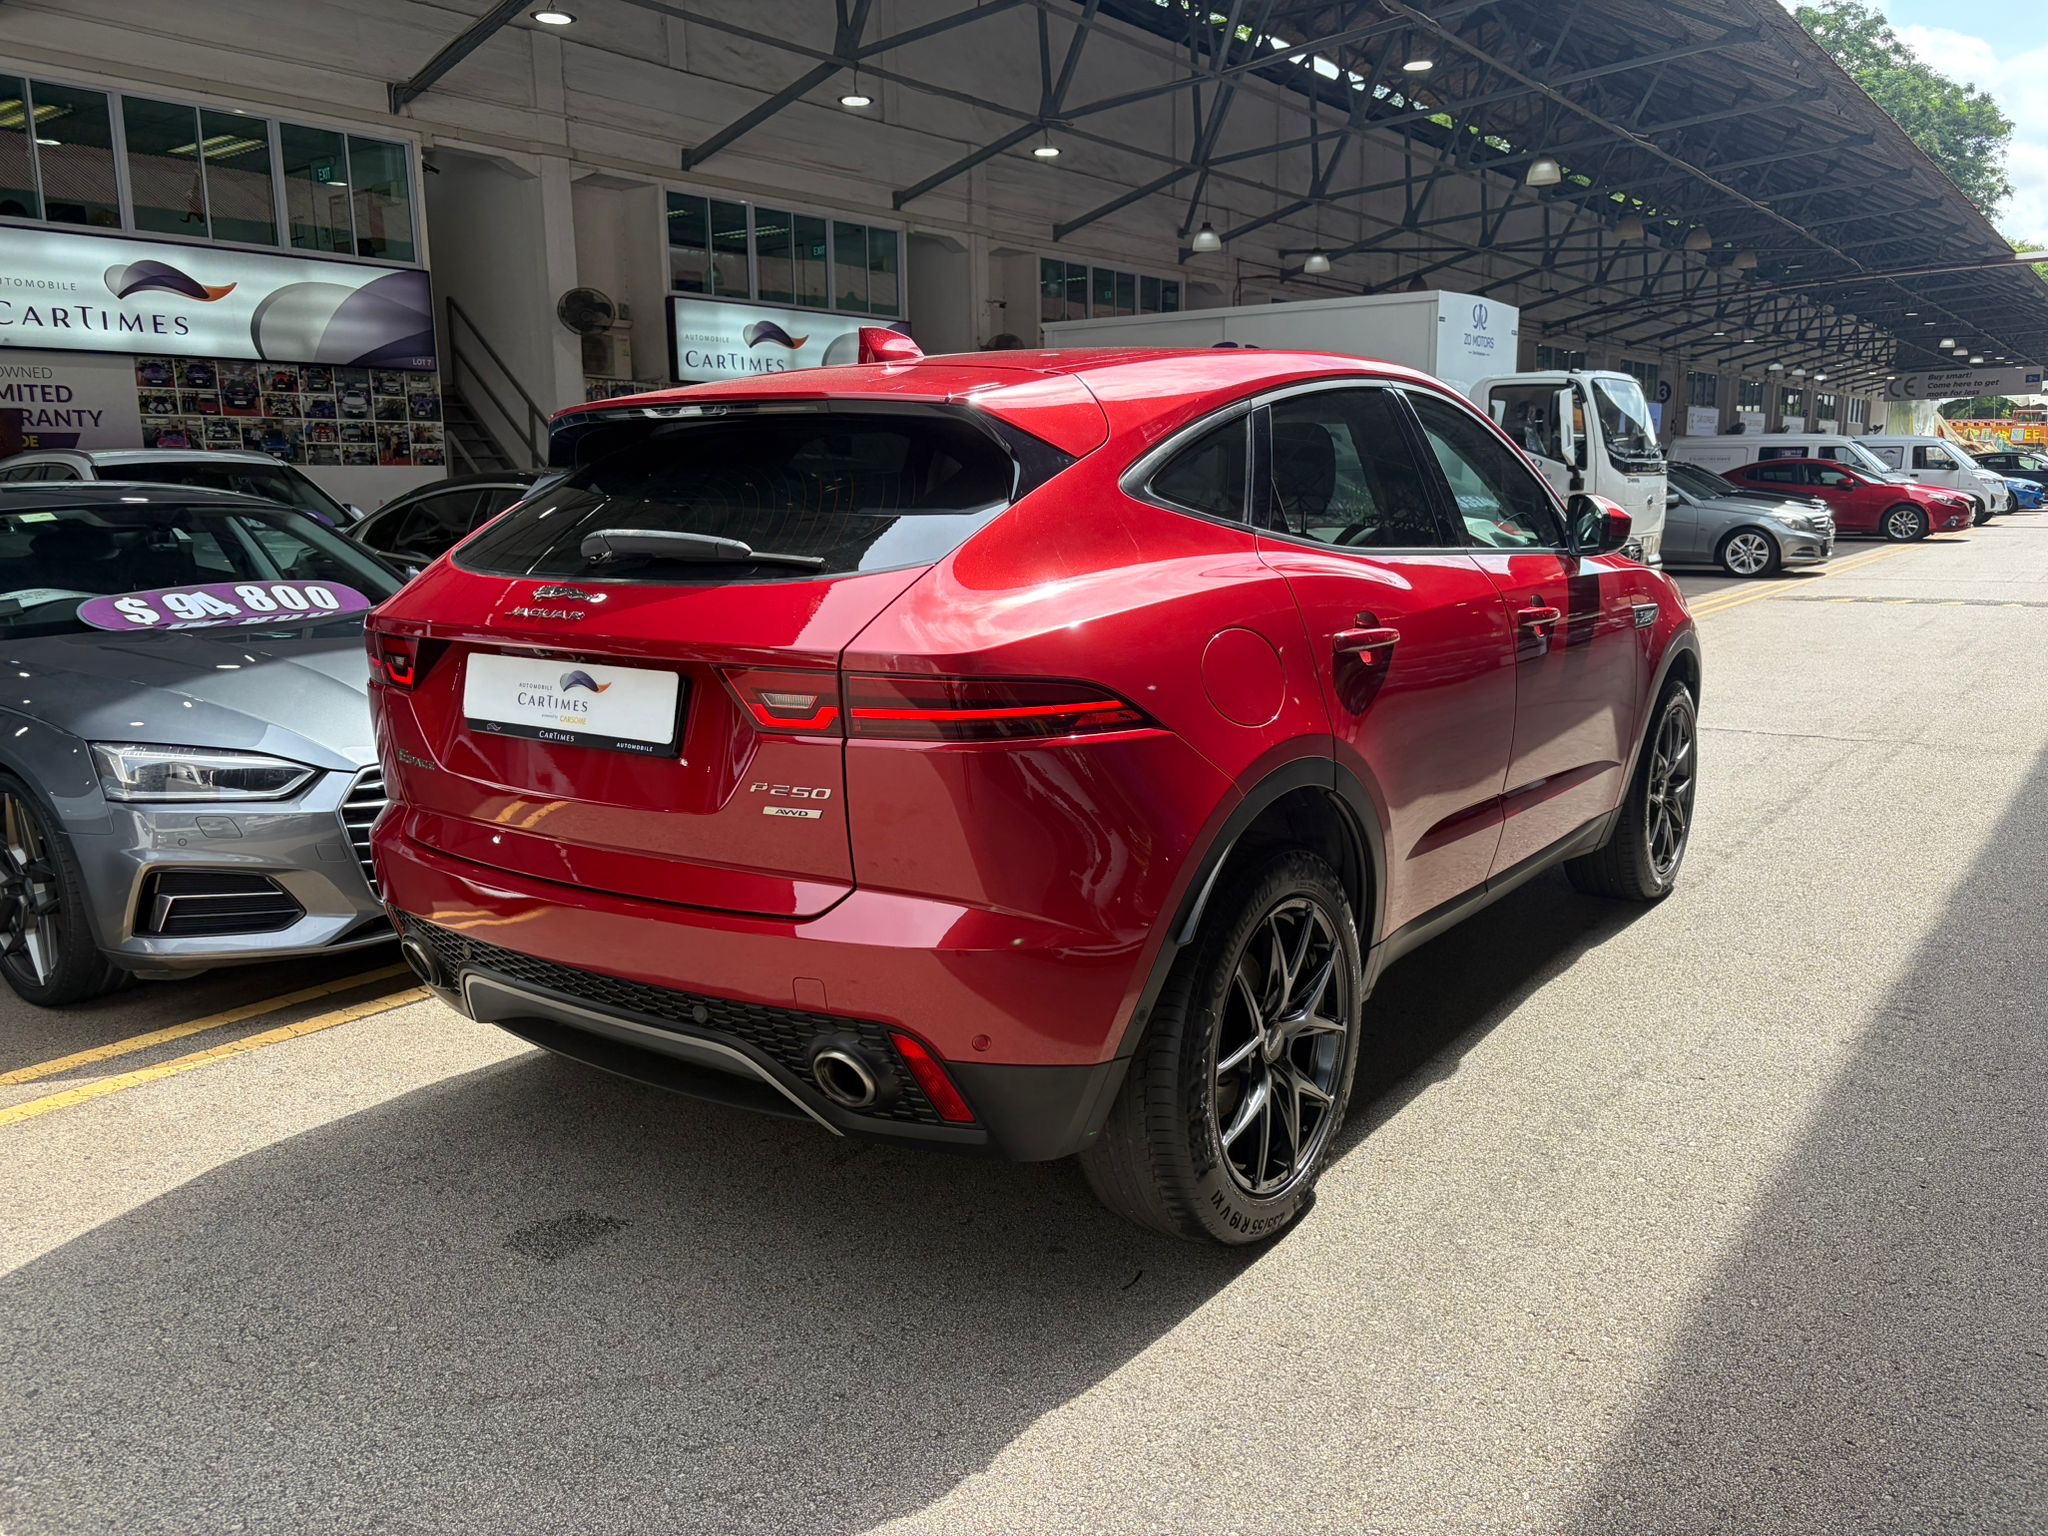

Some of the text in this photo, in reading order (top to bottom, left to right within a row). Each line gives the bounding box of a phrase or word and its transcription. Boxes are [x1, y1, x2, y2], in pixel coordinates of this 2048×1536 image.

[318, 167, 331, 181] EXIT
[0, 277, 77, 291] TOMOBILE
[685, 334, 729, 343] AUTOMOBILE
[1473, 335, 1494, 349] MOTORS
[412, 358, 425, 366] LOT
[685, 350, 785, 373] CARTIMES
[1928, 371, 1973, 382] Buy smart!
[1984, 379, 2000, 387] get
[1964, 388, 1980, 396] less
[22, 408, 103, 427] RANTY
[113, 596, 161, 625] $
[505, 605, 585, 621] JAGUAR
[519, 682, 553, 691] AUTOMOBILE
[517, 692, 588, 712] CARTIMES
[560, 714, 588, 725] CARSOME
[538, 730, 653, 752] CARTIMES AUTOMOBILE
[749, 782, 832, 800] P250
[775, 808, 809, 817] AWD
[1219, 1205, 1231, 1220] V
